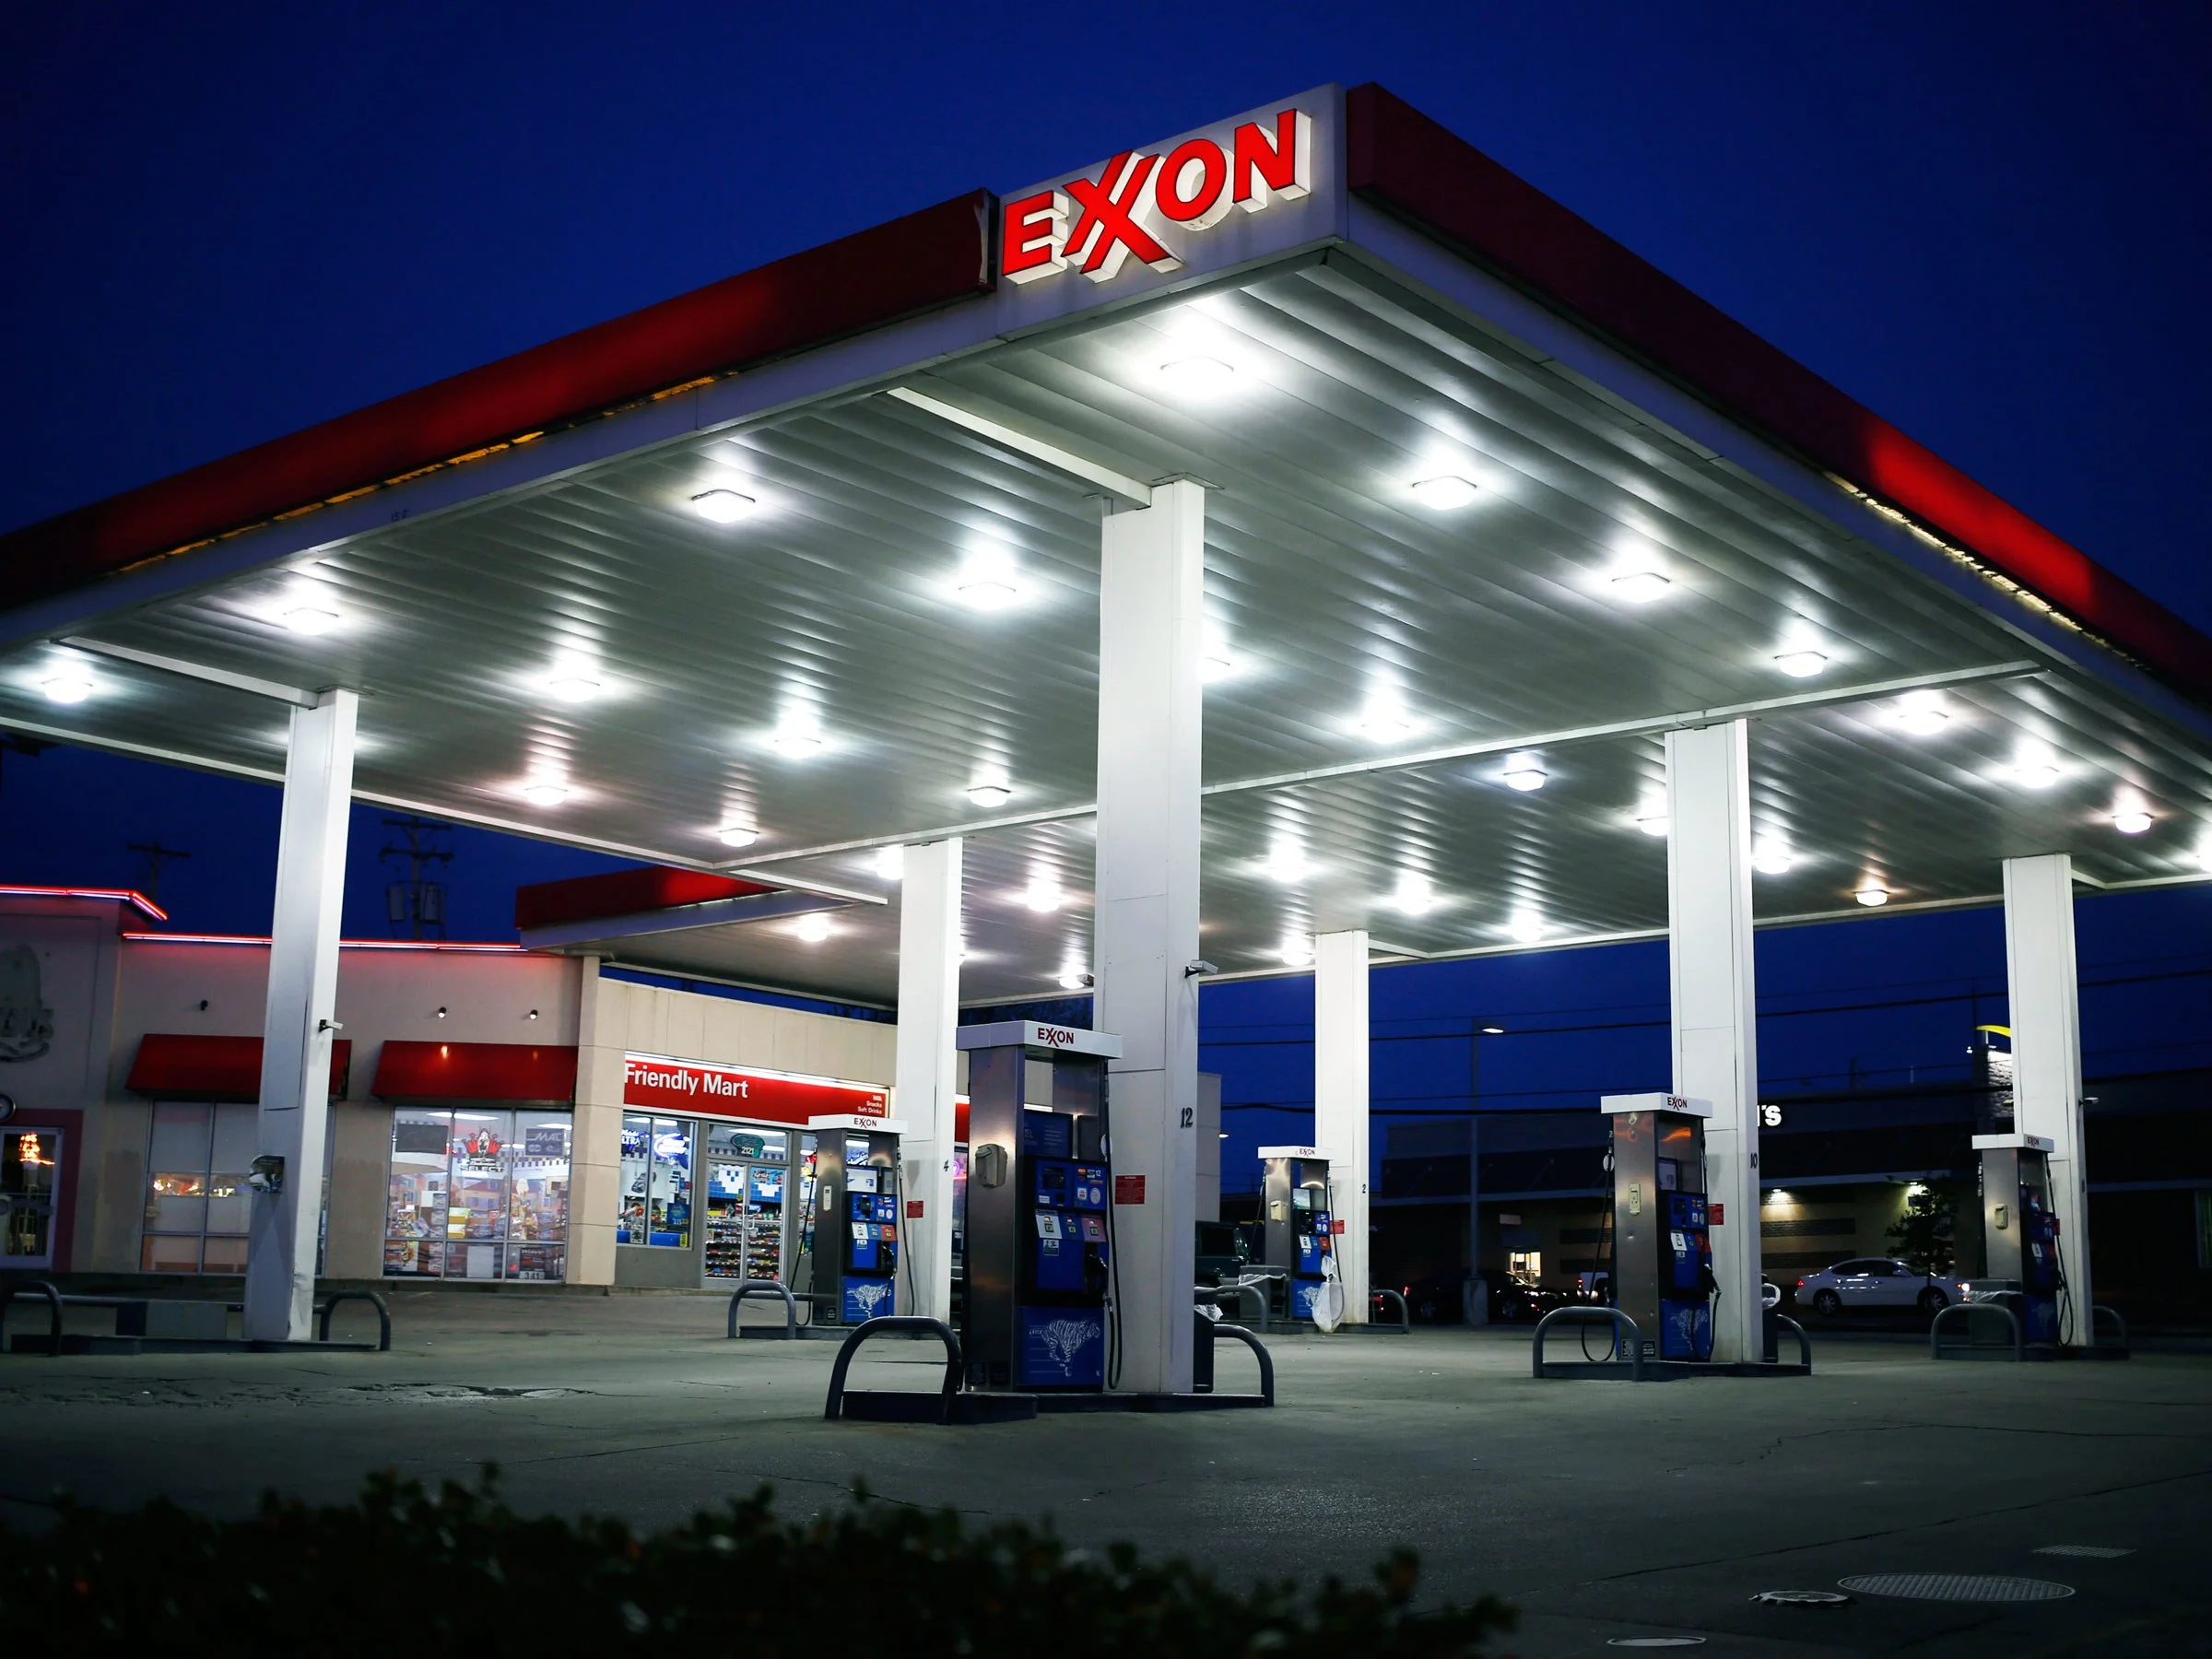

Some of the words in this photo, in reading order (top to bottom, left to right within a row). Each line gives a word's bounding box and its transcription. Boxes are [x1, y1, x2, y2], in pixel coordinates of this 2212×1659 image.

[1002, 108, 1304, 277] EXXON
[1038, 1028, 1075, 1047] EXXON
[624, 1063, 700, 1096] Friendly
[703, 1073, 748, 1098] Mart
[1667, 1097, 1687, 1111] EXXON
[853, 1117, 877, 1129] EXXON
[1180, 1107, 1194, 1128] 12
[741, 1147, 755, 1156] 2121
[943, 1159, 949, 1172] 4
[1749, 1153, 1759, 1169] 10
[1361, 1183, 1367, 1194] 2
